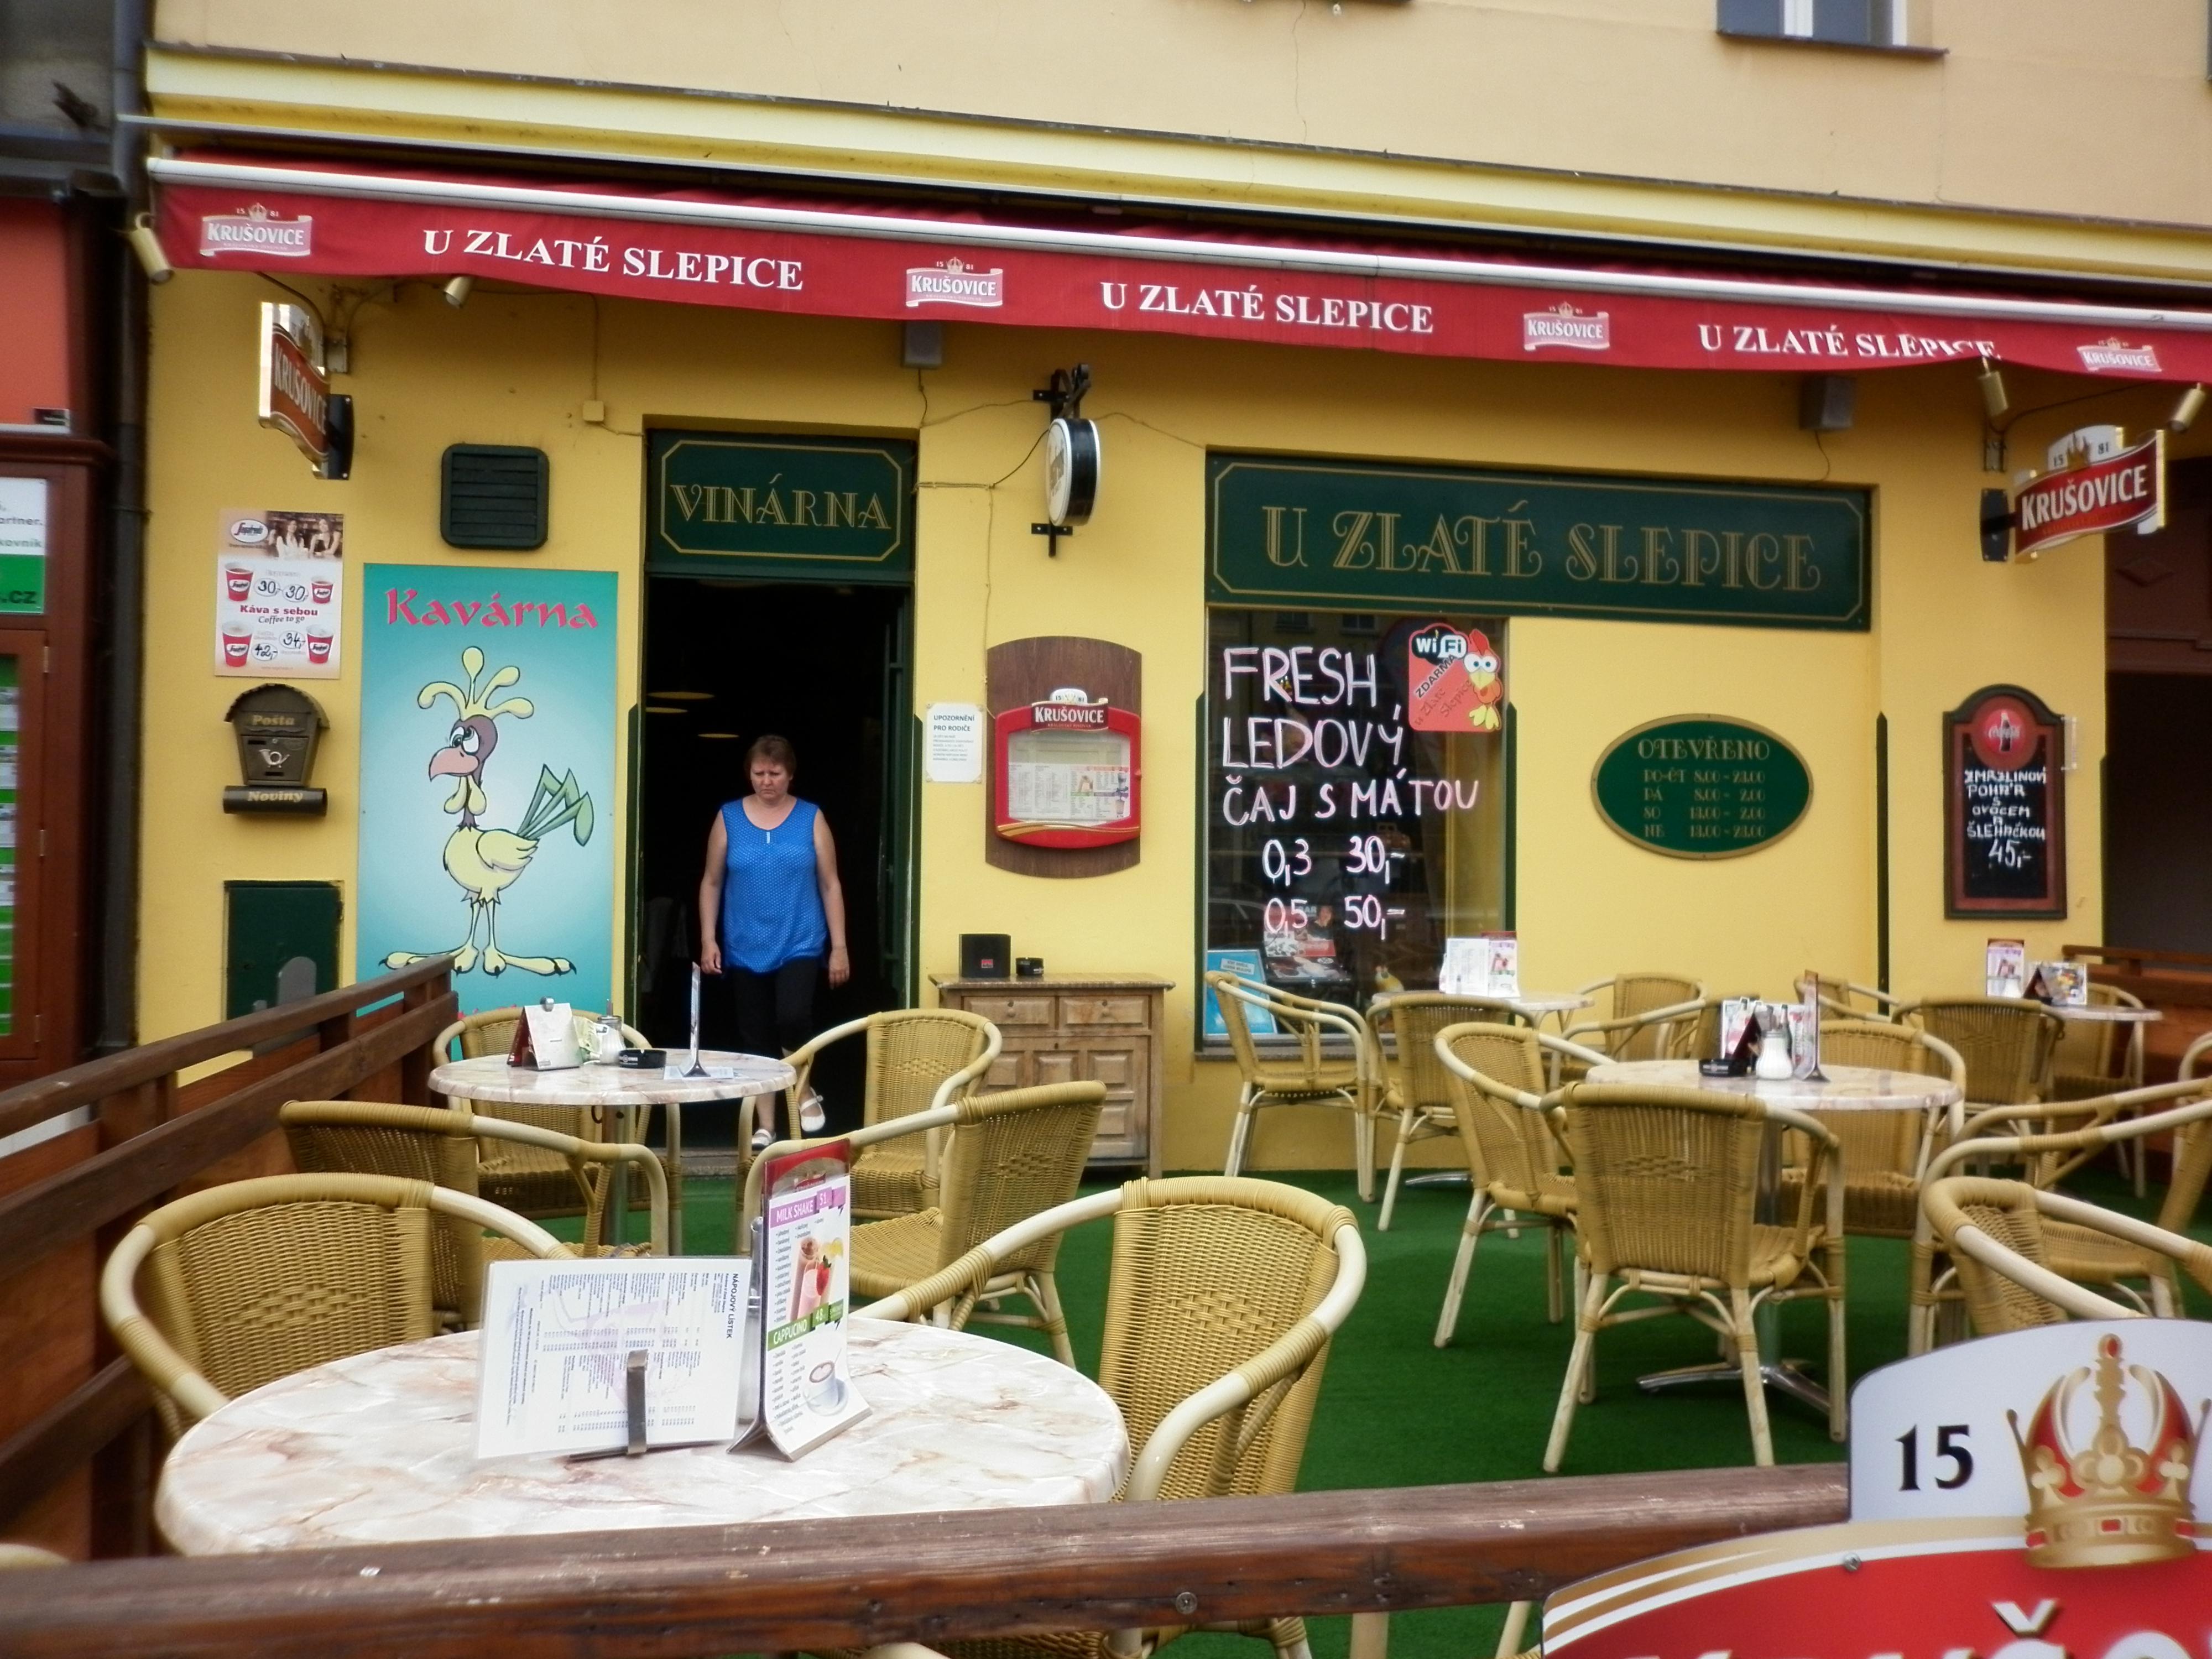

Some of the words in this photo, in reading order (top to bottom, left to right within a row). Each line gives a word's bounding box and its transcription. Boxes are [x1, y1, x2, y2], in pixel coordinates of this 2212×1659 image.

[207, 222, 304, 246] KRUŠOVICE
[423, 229, 453, 255] U
[463, 229, 611, 273] ZLATÉ
[623, 247, 803, 290] SLEPICE
[911, 275, 997, 296] KRUŠOVICE
[1100, 281, 1128, 310] U
[1139, 284, 1265, 321] ZLATÉ
[1275, 294, 1434, 333] SLEPICE
[1527, 319, 1604, 338] KRUŠOVICE
[1698, 324, 1723, 351] U
[1734, 324, 1849, 357] ZLATÉ
[2053, 453, 2064, 467] 15
[670, 473, 891, 529] VINÁRNA
[2021, 465, 2148, 531] KRUŠOVICE
[1262, 505, 1309, 568] U
[1332, 499, 1543, 578] ZLATÉ
[1566, 523, 1821, 592] SLEPICE
[240, 604, 269, 614] Káva
[283, 607, 318, 616] sebou
[258, 615, 284, 624] Coffee
[295, 616, 305, 624] go
[385, 587, 598, 629] Kavárna
[1223, 646, 1378, 707] FRESH
[1415, 654, 1457, 698] ZDARMA
[1034, 706, 1104, 723] KRUŠOVICE
[1222, 703, 1404, 769] LEDOVÝ
[1637, 735, 1770, 760] OTEVŘENO
[247, 791, 304, 803] Noviny
[1223, 774, 1297, 826] ČAJ
[1314, 781, 1337, 819] S
[1350, 767, 1479, 819] MÁTOU
[1972, 805, 2030, 818] OVOCEM
[1261, 838, 1312, 886] 0,3
[1264, 897, 1308, 937] 0,5
[776, 1207, 793, 1223] MILK
[793, 1199, 814, 1218] SHAKE
[729, 1273, 739, 1312] NÁPOJOVÝ
[726, 1313, 735, 1339] LÍSTEK
[1895, 1423, 1974, 1491] 15
